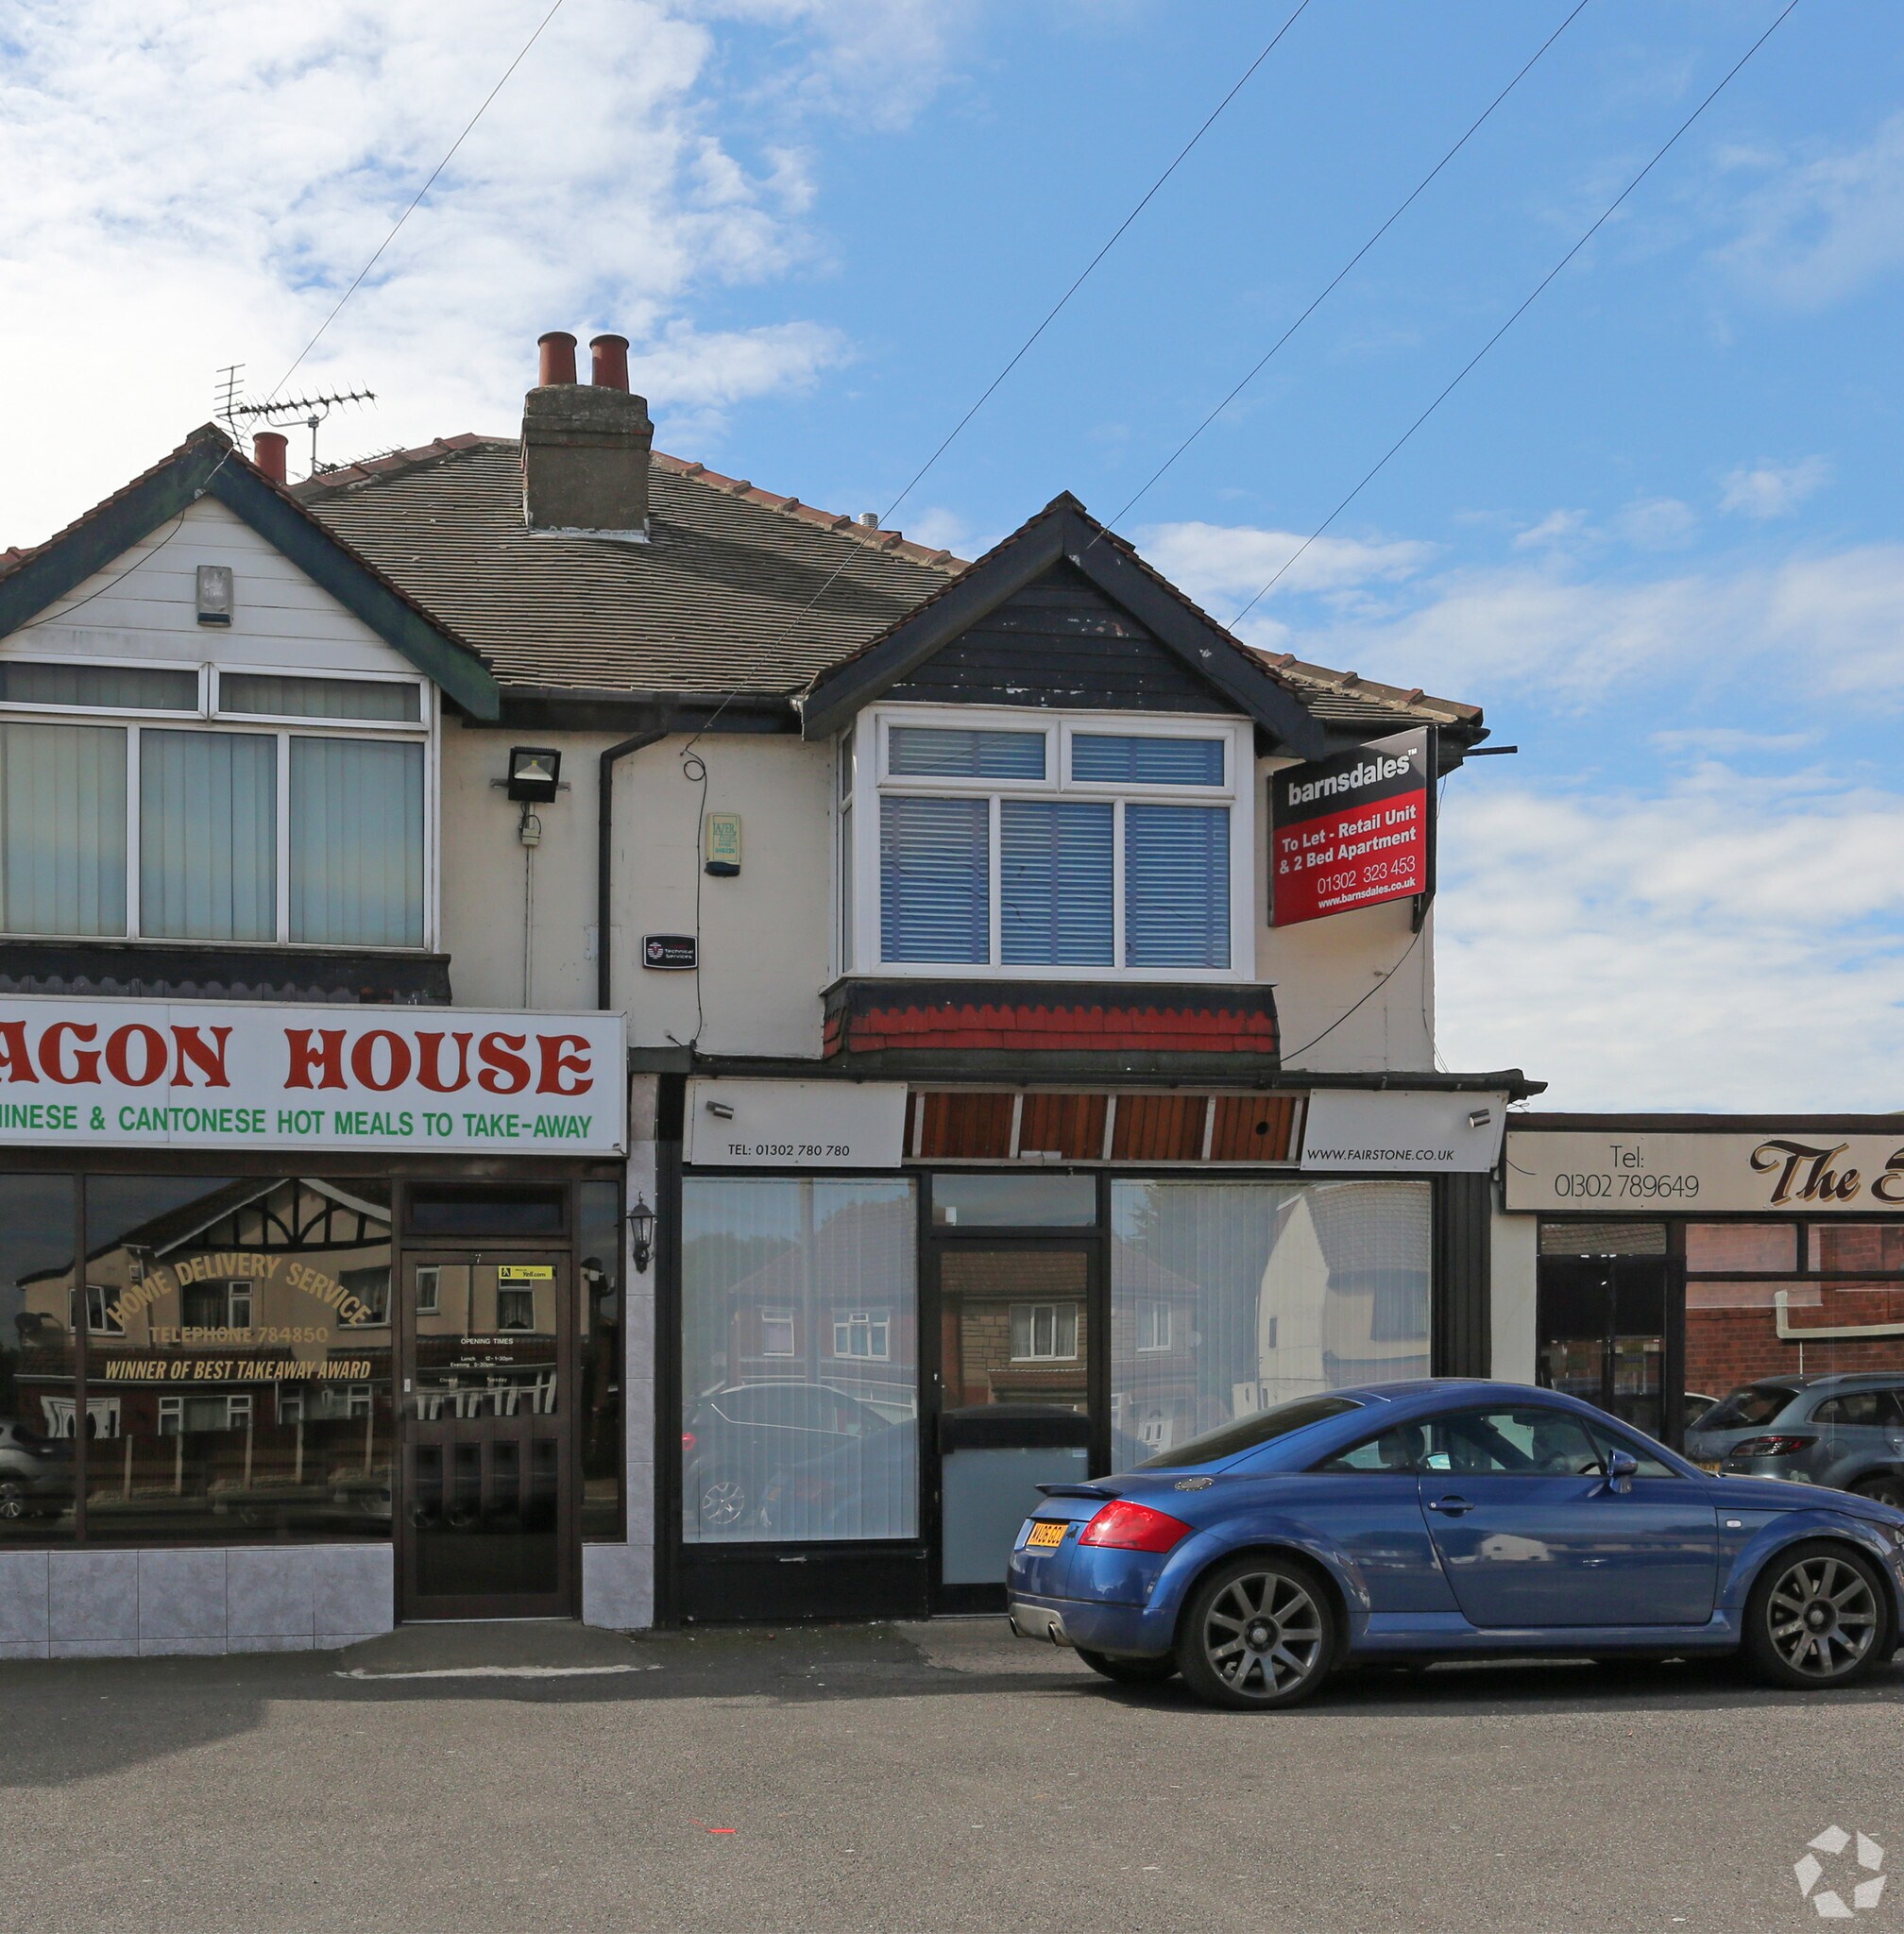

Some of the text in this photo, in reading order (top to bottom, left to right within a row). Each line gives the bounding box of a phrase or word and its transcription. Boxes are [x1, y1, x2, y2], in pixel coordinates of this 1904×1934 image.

[1283, 838, 1299, 853] To
[1302, 829, 1326, 847] Let
[1338, 815, 1381, 839] Retail
[1386, 804, 1417, 824] Unit
[1280, 825, 1417, 874] & 2 Bed Apartment
[1318, 856, 1416, 894] 01302 323 453
[1318, 876, 1416, 908] www.barnsdales.co.uk
[283, 1028, 594, 1095] HOUSE
[0, 1104, 593, 1139] INESE & CANTONESE HOT MEALS TO TAKE-AWAY
[728, 1145, 850, 1156] TEL: 01302 780 780
[1307, 1149, 1455, 1161] WWW.FAIRSTONE.CO.UK
[1610, 1145, 1644, 1168] Tel:
[1555, 1174, 1699, 1197] 01302 789649
[1750, 1140, 1862, 1207] The
[106, 1253, 372, 1326] HOME DELIVERY SERVICE
[149, 1327, 329, 1343] TELEPHONE 784850
[105, 1361, 371, 1380] WINNER OF BEST TAKEAWAY AWARD
